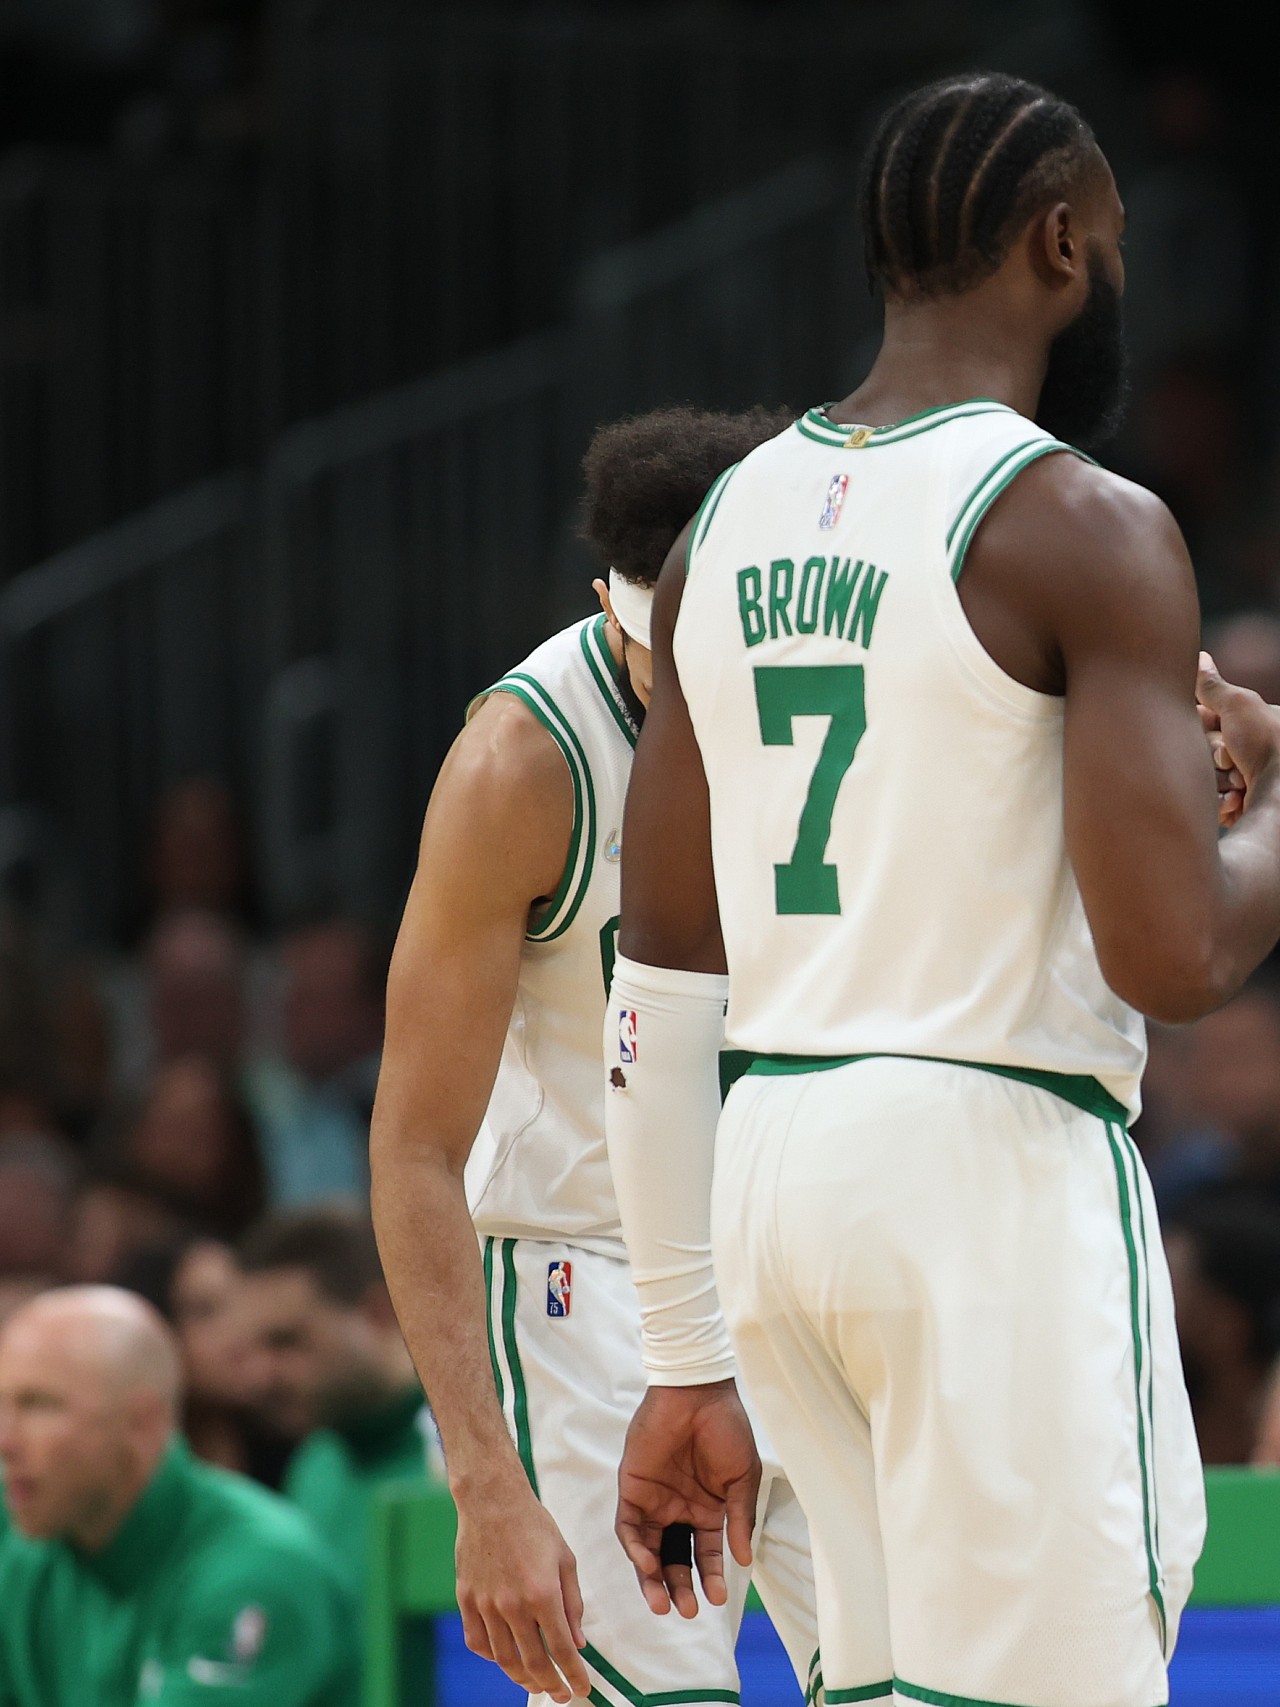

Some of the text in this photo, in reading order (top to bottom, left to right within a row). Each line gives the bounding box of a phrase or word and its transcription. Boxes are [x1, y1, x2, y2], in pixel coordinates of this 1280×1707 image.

[737, 556, 889, 649] BROWN
[753, 664, 867, 916] 7
[549, 1302, 559, 1315] 75
